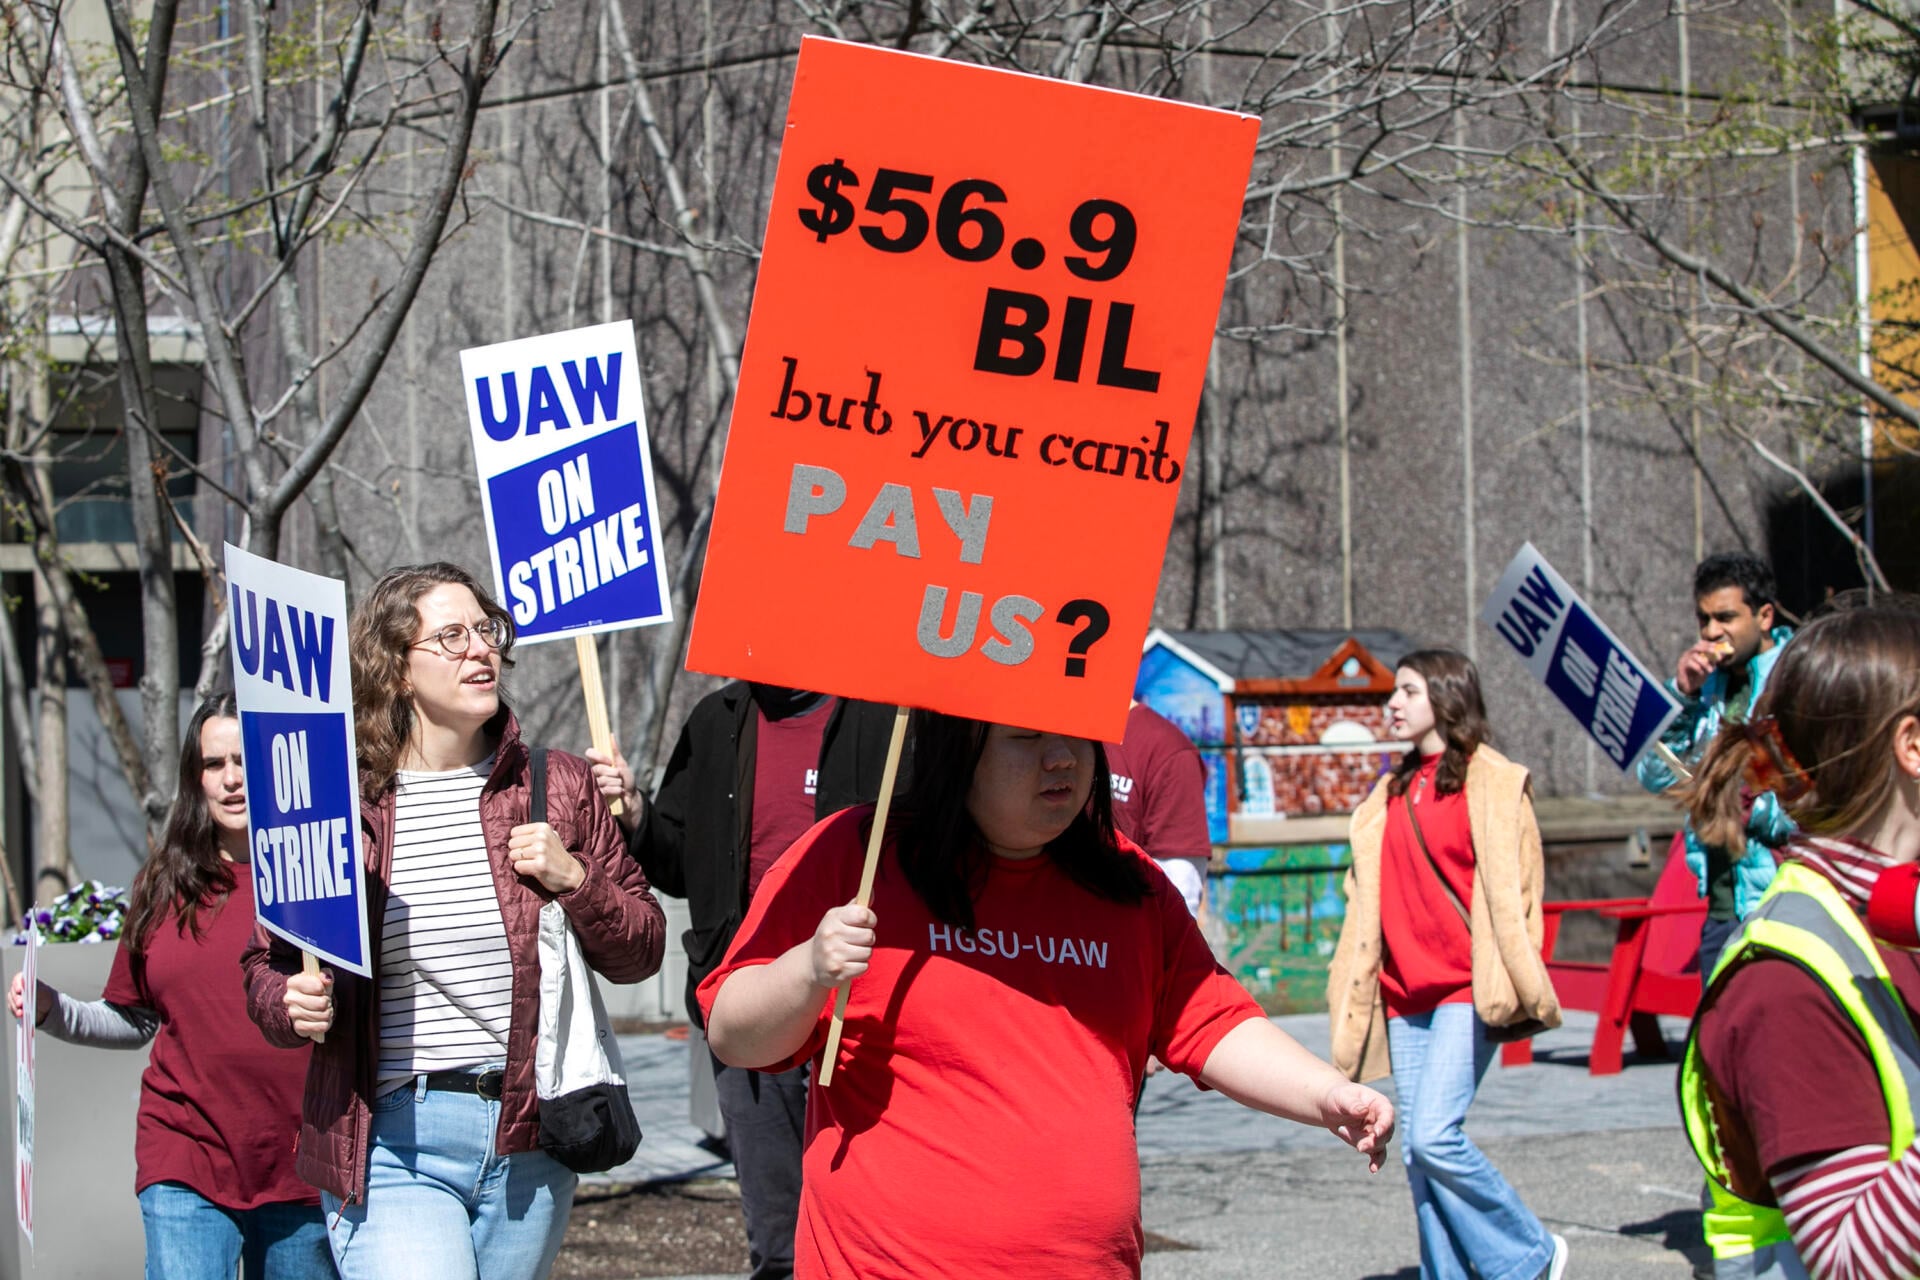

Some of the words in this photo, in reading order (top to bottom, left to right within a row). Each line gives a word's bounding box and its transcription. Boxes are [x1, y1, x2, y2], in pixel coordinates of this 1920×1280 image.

[798, 158, 1137, 282] $56.9
[973, 287, 1161, 394] BIL
[475, 351, 623, 442] UAW
[770, 356, 893, 436] but
[911, 410, 1024, 459] you
[1039, 420, 1181, 484] can't
[537, 452, 595, 535] ON
[784, 463, 993, 565] PAY
[508, 502, 649, 627] STRIKE
[1495, 563, 1566, 659] UAW
[231, 582, 335, 704] UAW
[1560, 636, 1600, 698] ON
[1591, 647, 1645, 763] STRIKE
[271, 730, 312, 814] ON
[1109, 773, 1134, 793] SU
[255, 817, 352, 907] STRIKE
[928, 923, 1109, 969] HGSU-UAW
